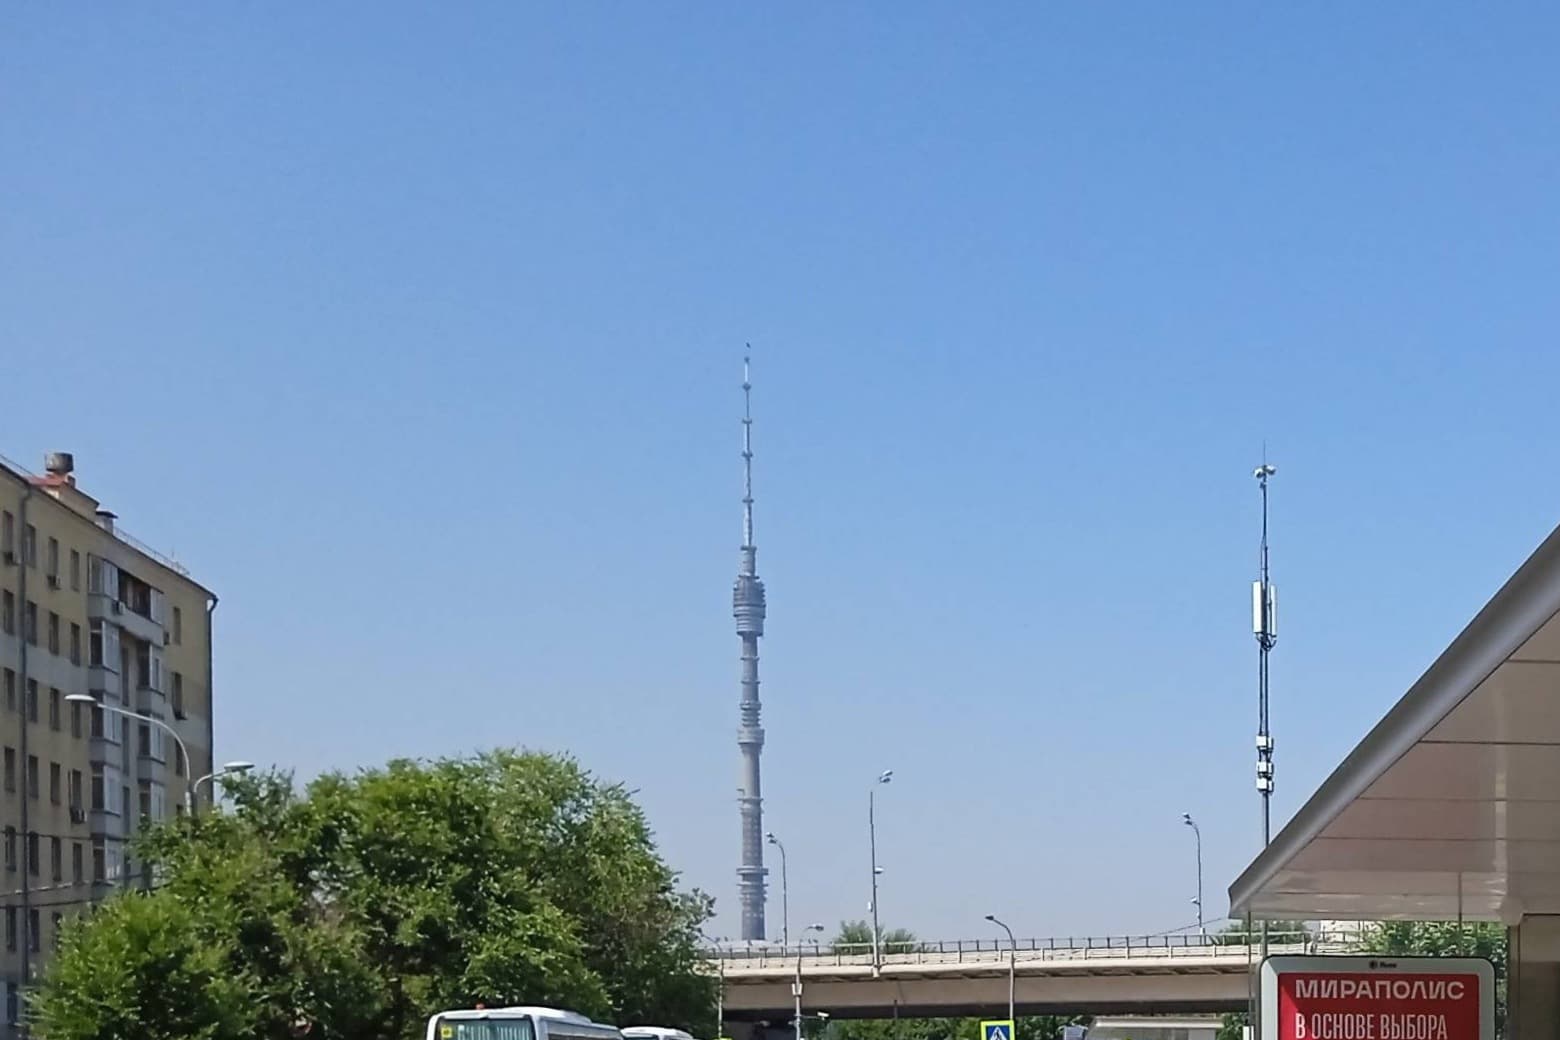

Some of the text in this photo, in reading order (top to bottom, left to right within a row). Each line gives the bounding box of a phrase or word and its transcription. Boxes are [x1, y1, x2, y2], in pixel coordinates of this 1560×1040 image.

[1296, 979, 1465, 1000] МИРАПОЛИС
[1295, 1013, 1448, 1040] В ОСНОВЕ ВЫБОРА
